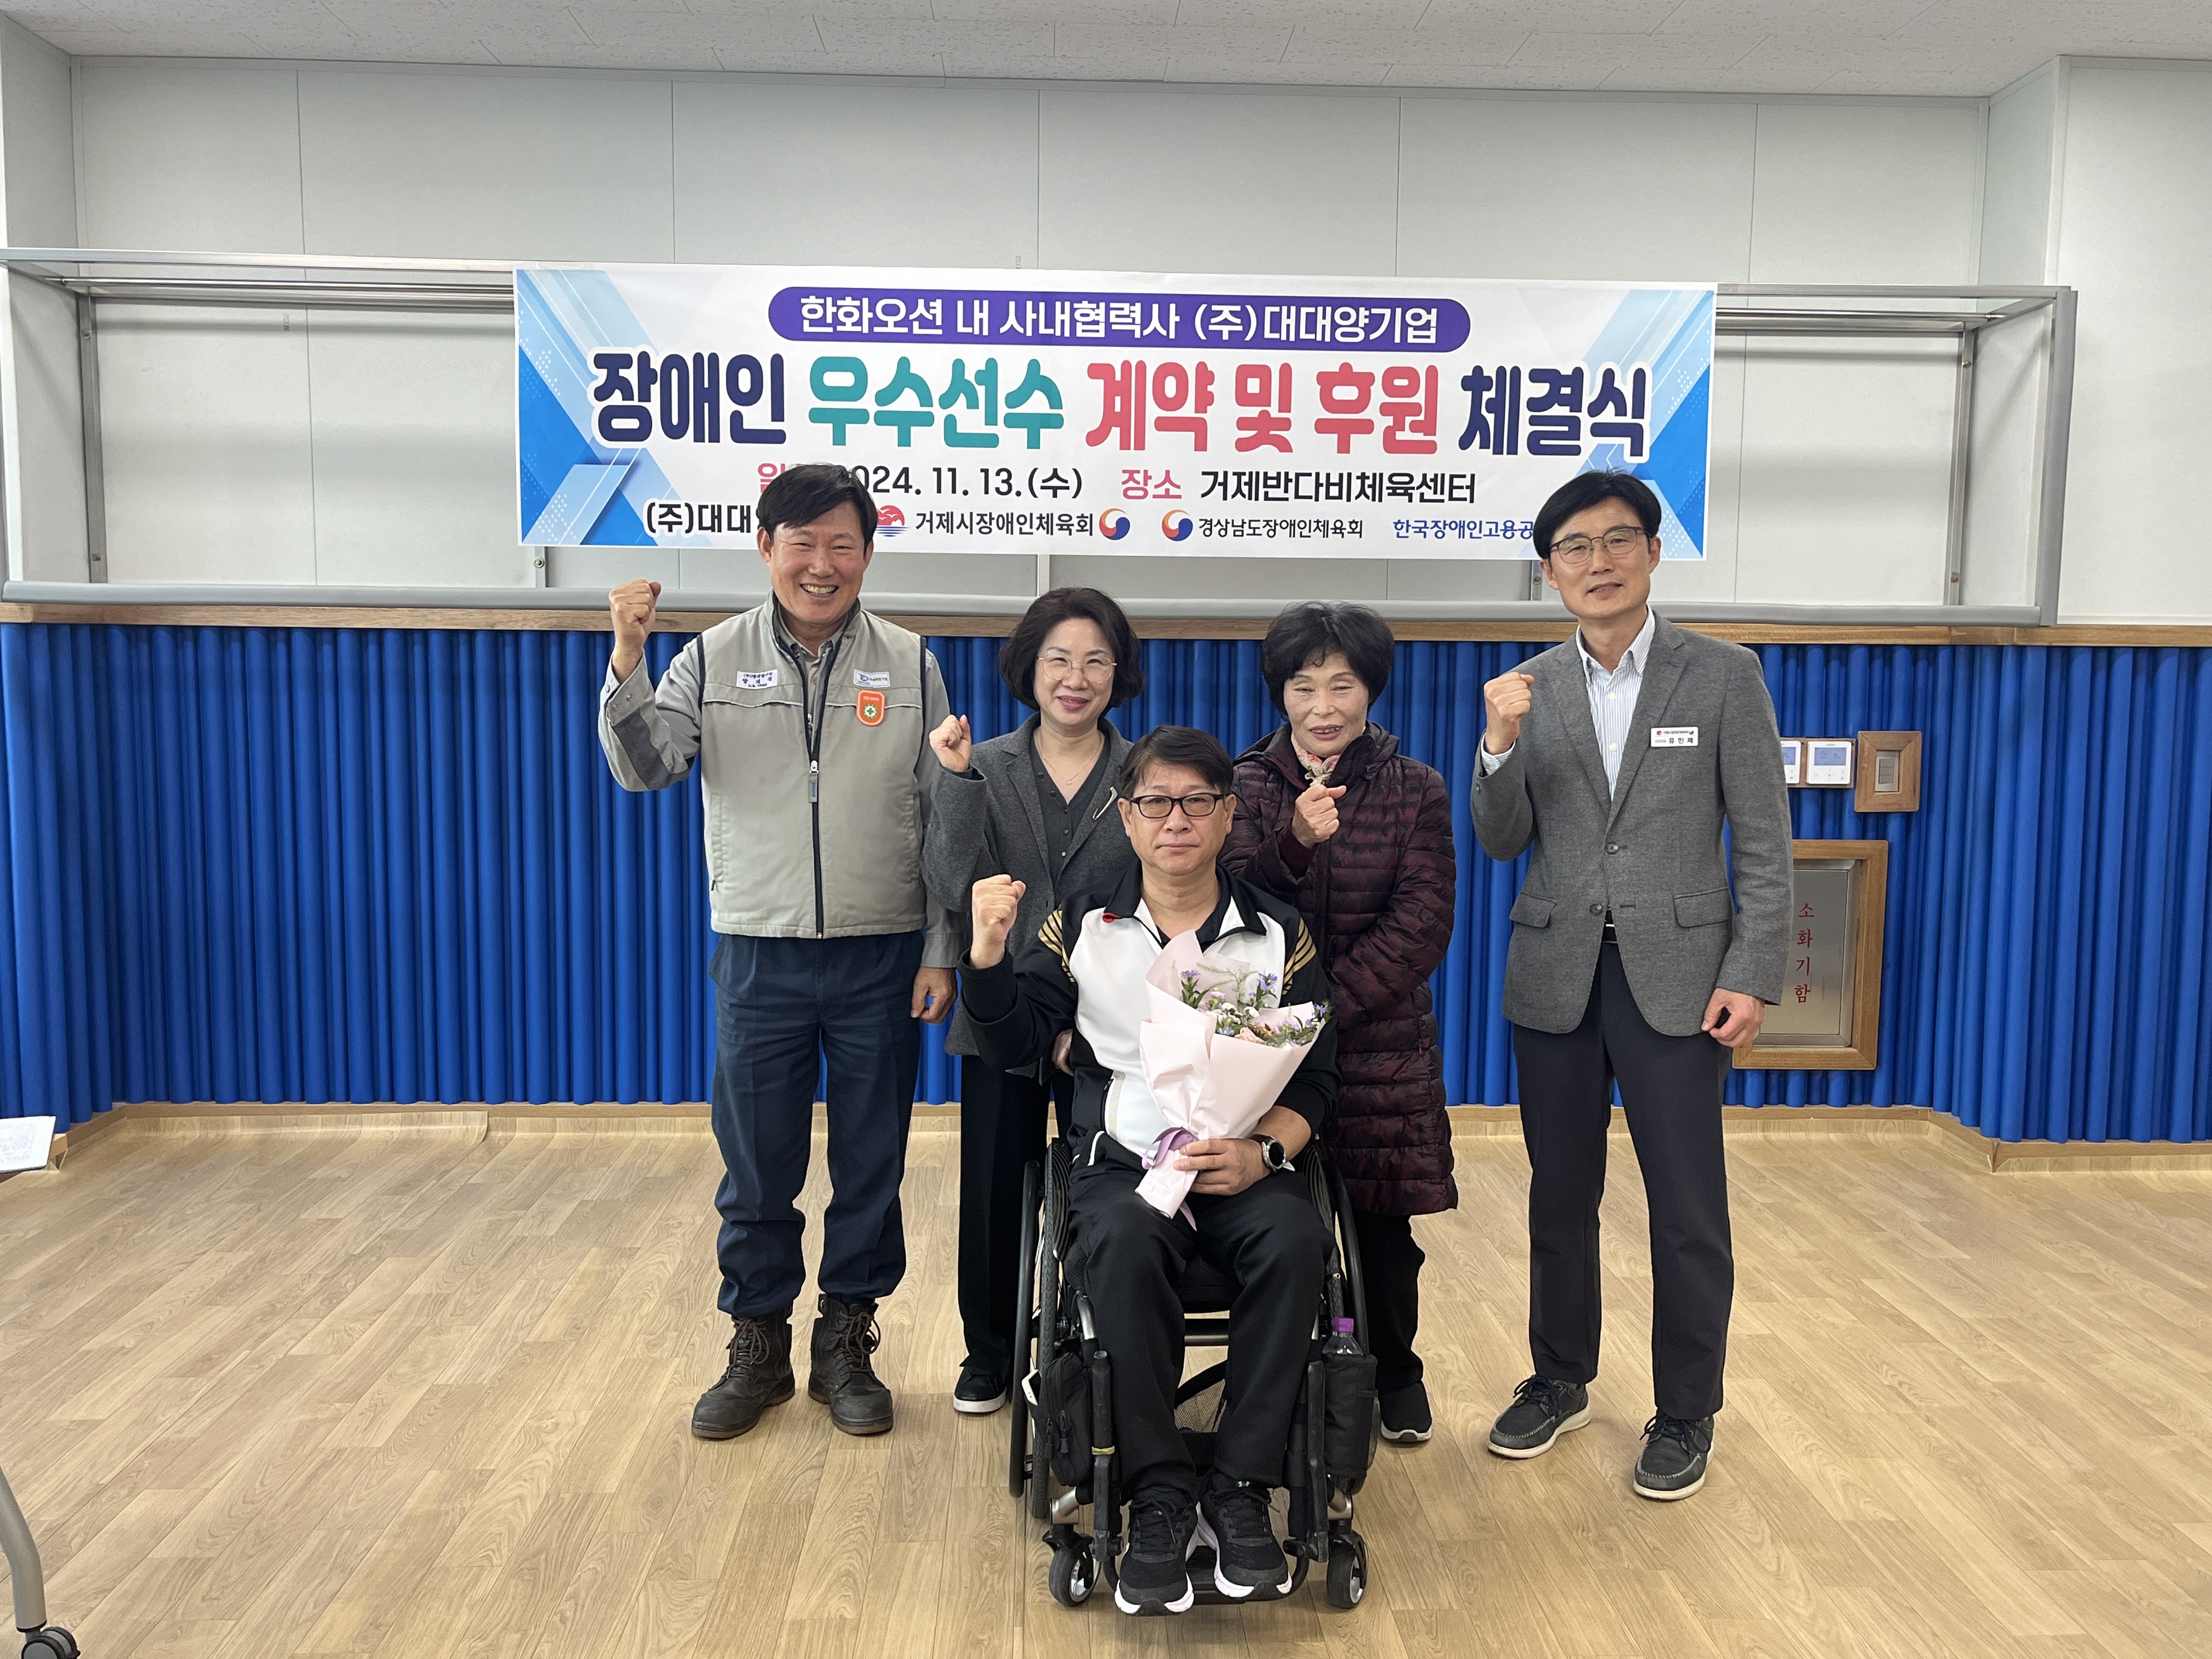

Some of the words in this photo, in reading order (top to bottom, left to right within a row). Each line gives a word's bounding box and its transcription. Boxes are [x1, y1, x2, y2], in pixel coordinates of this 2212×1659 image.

[800, 296, 943, 335] 한화오션
[957, 300, 989, 336] 내
[1000, 299, 1180, 339] 사내협력사
[1194, 303, 1438, 343] (주)대대양기업
[593, 351, 787, 444] 장애인
[809, 356, 1064, 449] 우수선수
[1086, 360, 1215, 452] 계약
[1235, 363, 1293, 453] 및
[1314, 362, 1438, 454] 후원
[1459, 365, 1646, 457] 체결식
[851, 465, 921, 495] 024.
[933, 467, 969, 495] 11.
[1121, 469, 1182, 500] 장소
[1201, 471, 1475, 504] 거제반다비체육센터
[647, 503, 751, 534] (주)대대
[916, 511, 1093, 536] 거제시장애인체육회
[1199, 518, 1363, 539] 경상남도장애인체육회
[1393, 519, 1533, 540] 한국장애인고용공
[1795, 903, 1814, 1003] 소화기함
